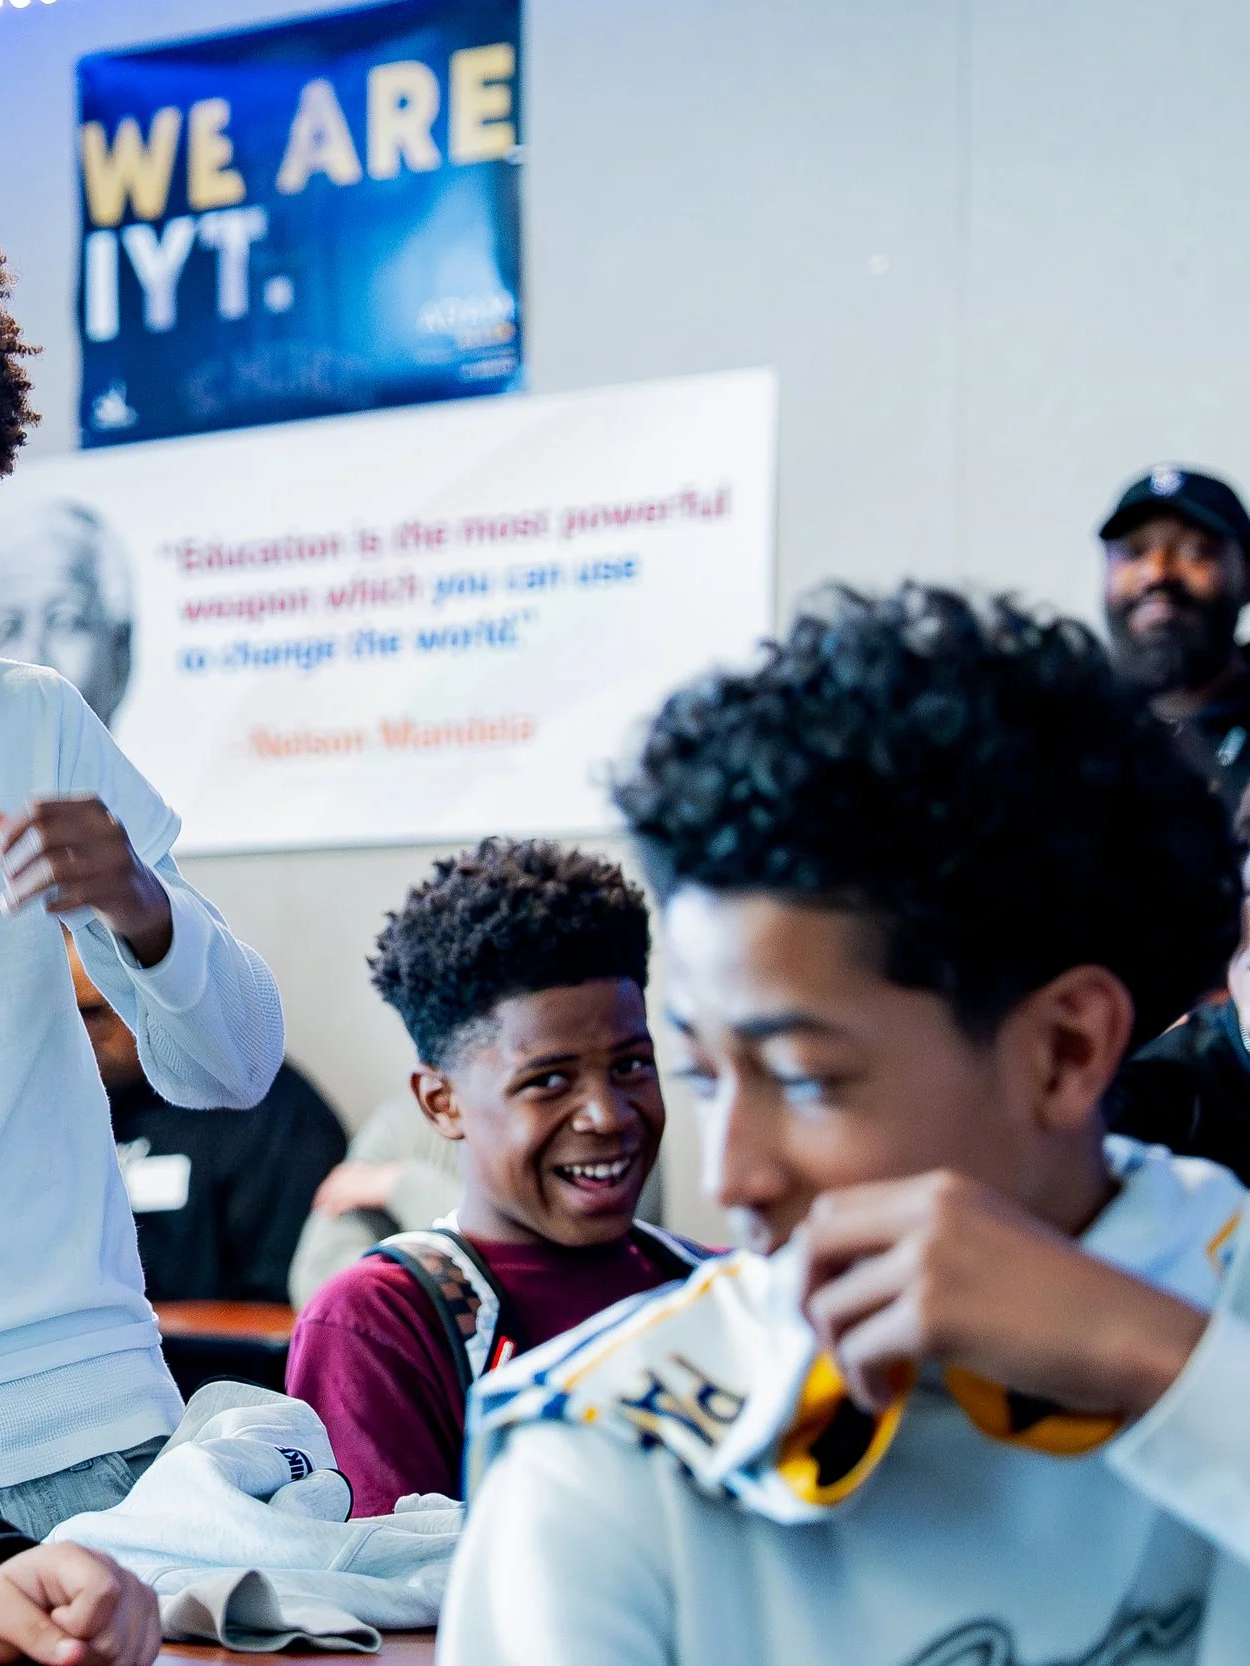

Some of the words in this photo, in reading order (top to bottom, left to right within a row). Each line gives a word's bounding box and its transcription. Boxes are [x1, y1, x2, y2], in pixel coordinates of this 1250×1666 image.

[81, 96, 246, 228] WE
[277, 42, 516, 195] ARE
[84, 205, 295, 342] IYT.
[356, 527, 380, 553] is
[395, 516, 447, 548] the
[462, 510, 546, 543] most
[562, 484, 731, 538] powerful
[181, 587, 308, 622] weapon
[327, 571, 417, 606] which
[432, 571, 488, 609] you
[505, 563, 559, 590] can
[576, 555, 637, 585] use
[178, 642, 206, 672] to
[222, 628, 335, 677] change
[351, 621, 402, 656] the
[378, 708, 534, 752] Mandela
